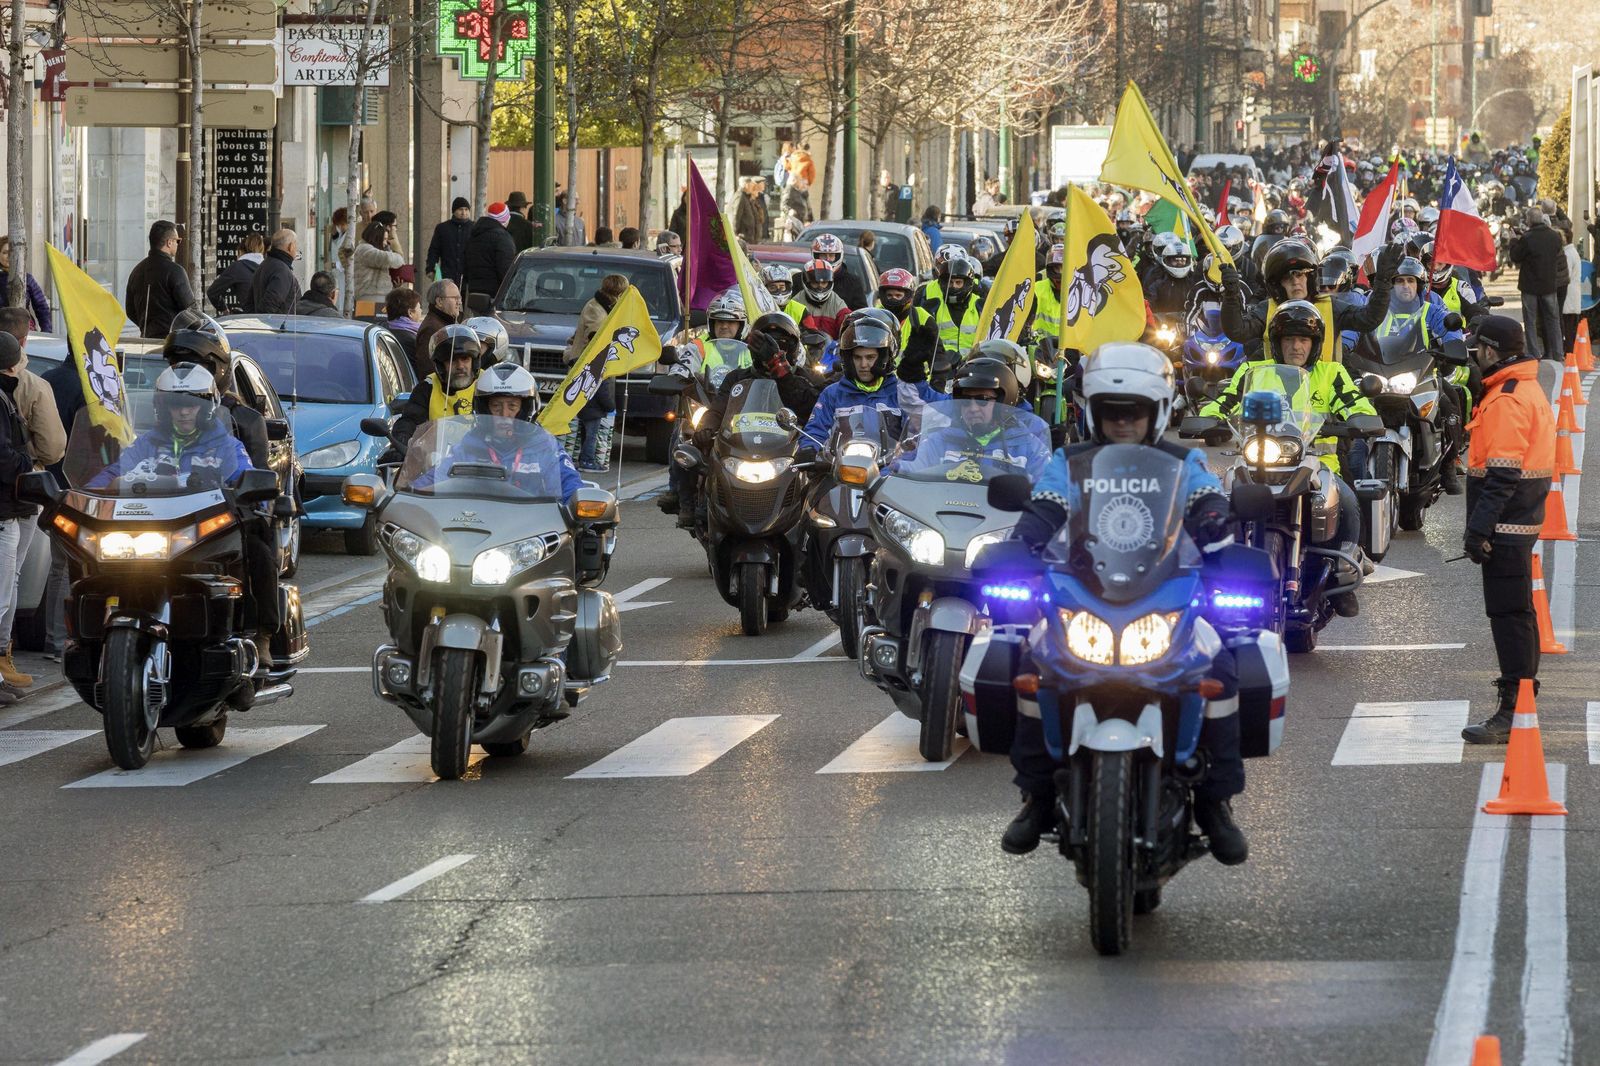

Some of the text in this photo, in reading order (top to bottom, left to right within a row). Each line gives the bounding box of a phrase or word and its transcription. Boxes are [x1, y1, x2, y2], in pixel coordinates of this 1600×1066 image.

[295, 69, 379, 80] ARTESAA
[234, 153, 247, 162] de
[251, 153, 268, 162] Sa
[903, 187, 912, 199] P
[1083, 478, 1161, 493] POLICIA
[945, 500, 980, 508] HONDA
